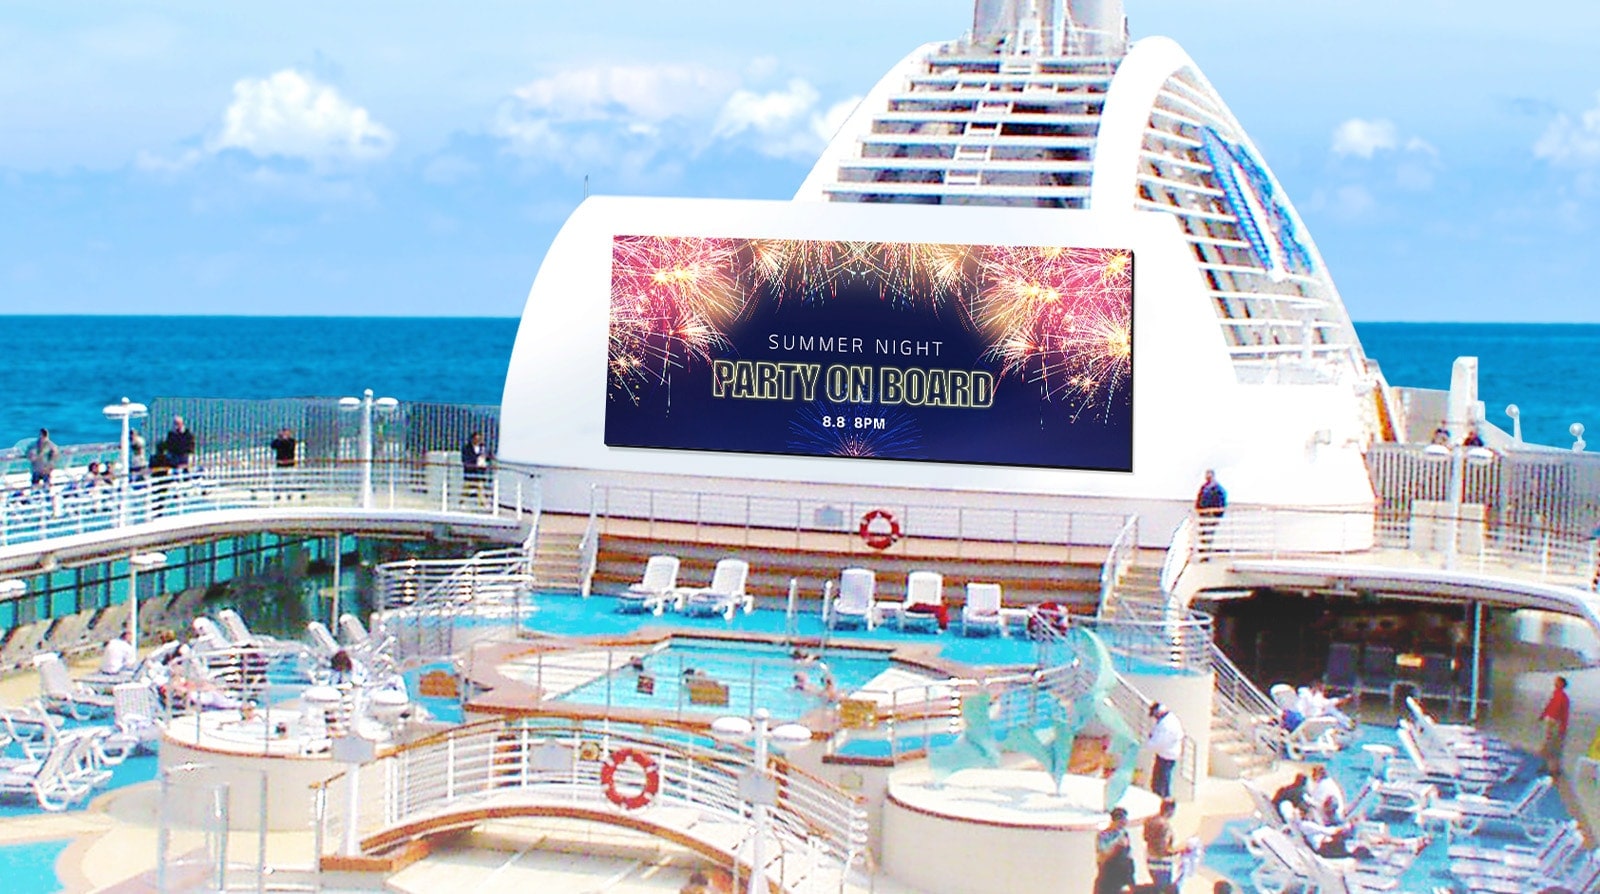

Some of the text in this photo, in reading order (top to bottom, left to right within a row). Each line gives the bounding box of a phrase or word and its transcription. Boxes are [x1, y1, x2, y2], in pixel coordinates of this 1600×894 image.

[768, 334, 943, 357] SUMMER NIGHT
[713, 360, 993, 408] PARTY ON BOARD
[822, 415, 886, 430] 8.8 8PM
